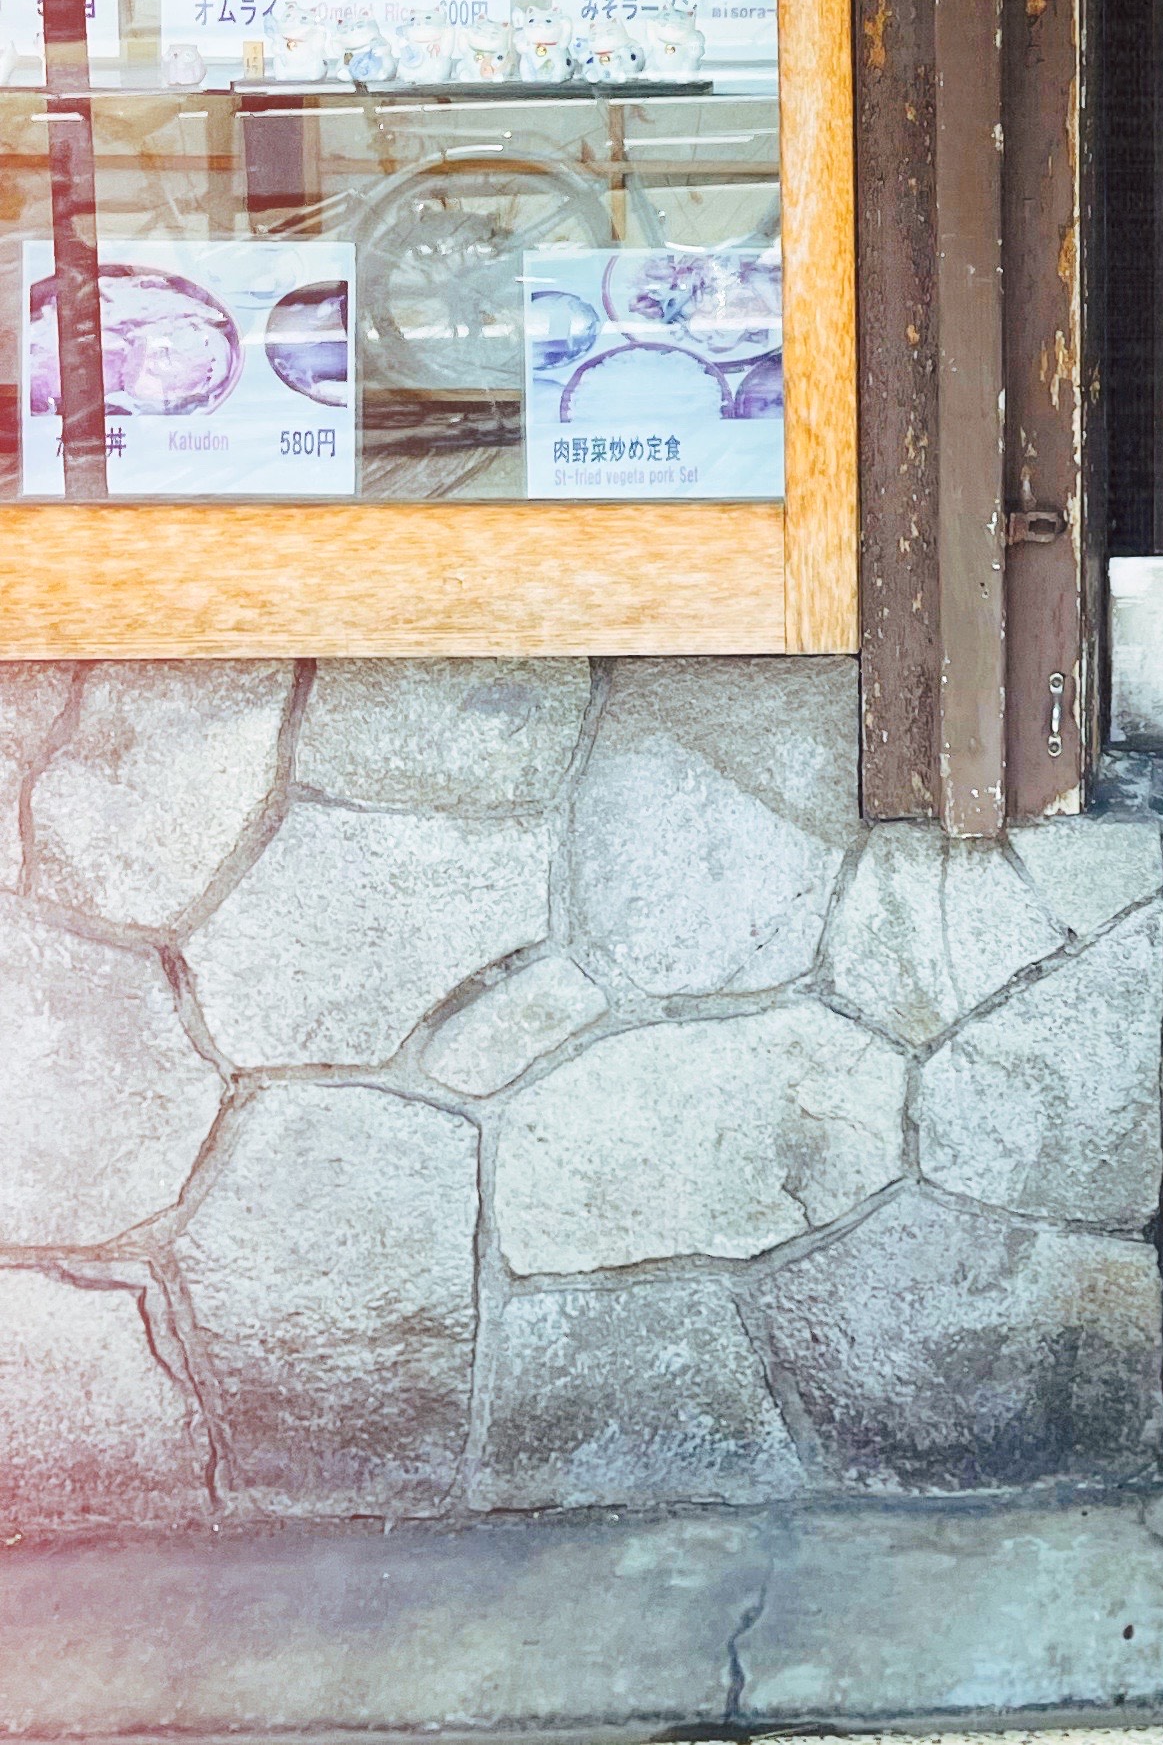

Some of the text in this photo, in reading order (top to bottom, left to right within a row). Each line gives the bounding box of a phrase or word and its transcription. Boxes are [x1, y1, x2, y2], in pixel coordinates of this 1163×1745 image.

[168, 427, 337, 458] Katudon 580円
[553, 433, 682, 465] 肉野菜炒め定食
[649, 465, 675, 486] pork
[679, 465, 699, 484] Set
